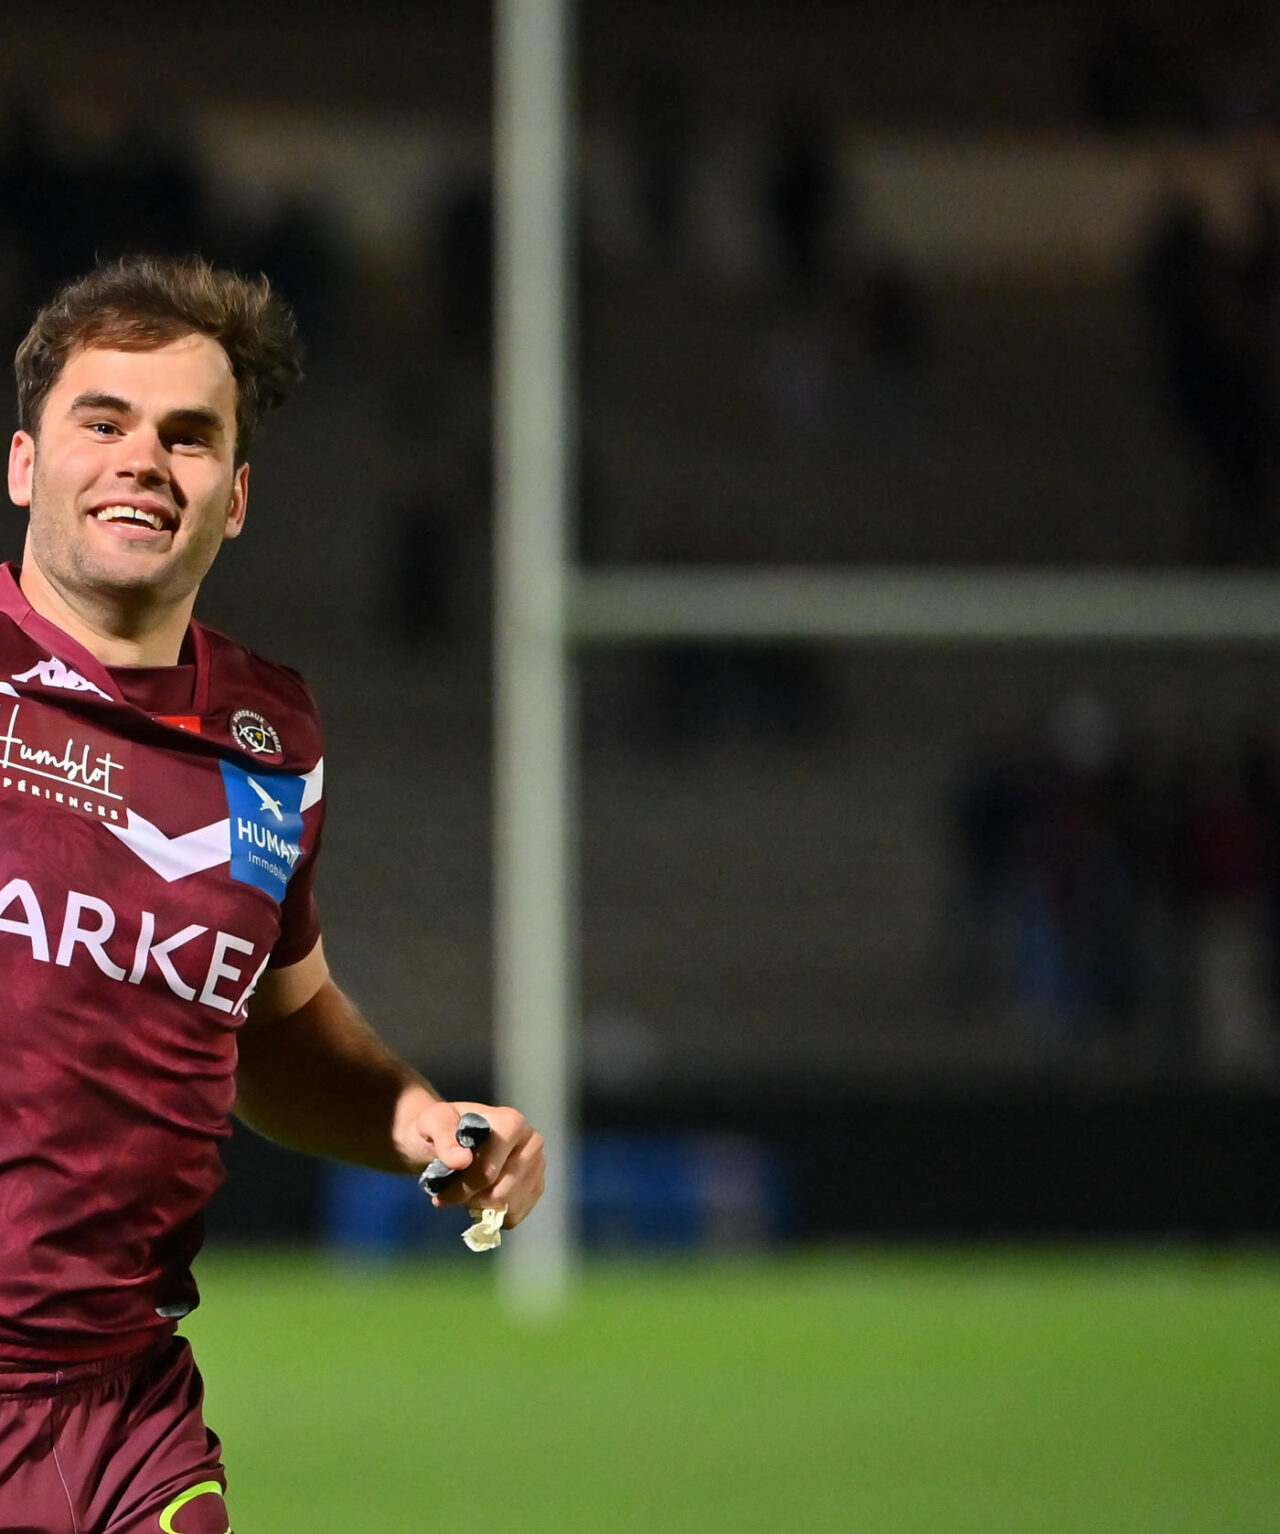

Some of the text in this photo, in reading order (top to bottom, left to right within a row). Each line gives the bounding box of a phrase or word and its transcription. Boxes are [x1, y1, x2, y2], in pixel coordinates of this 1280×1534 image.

[233, 710, 265, 723] BORDEAUX
[232, 725, 247, 750] UNION
[248, 850, 288, 884] Immobilie
